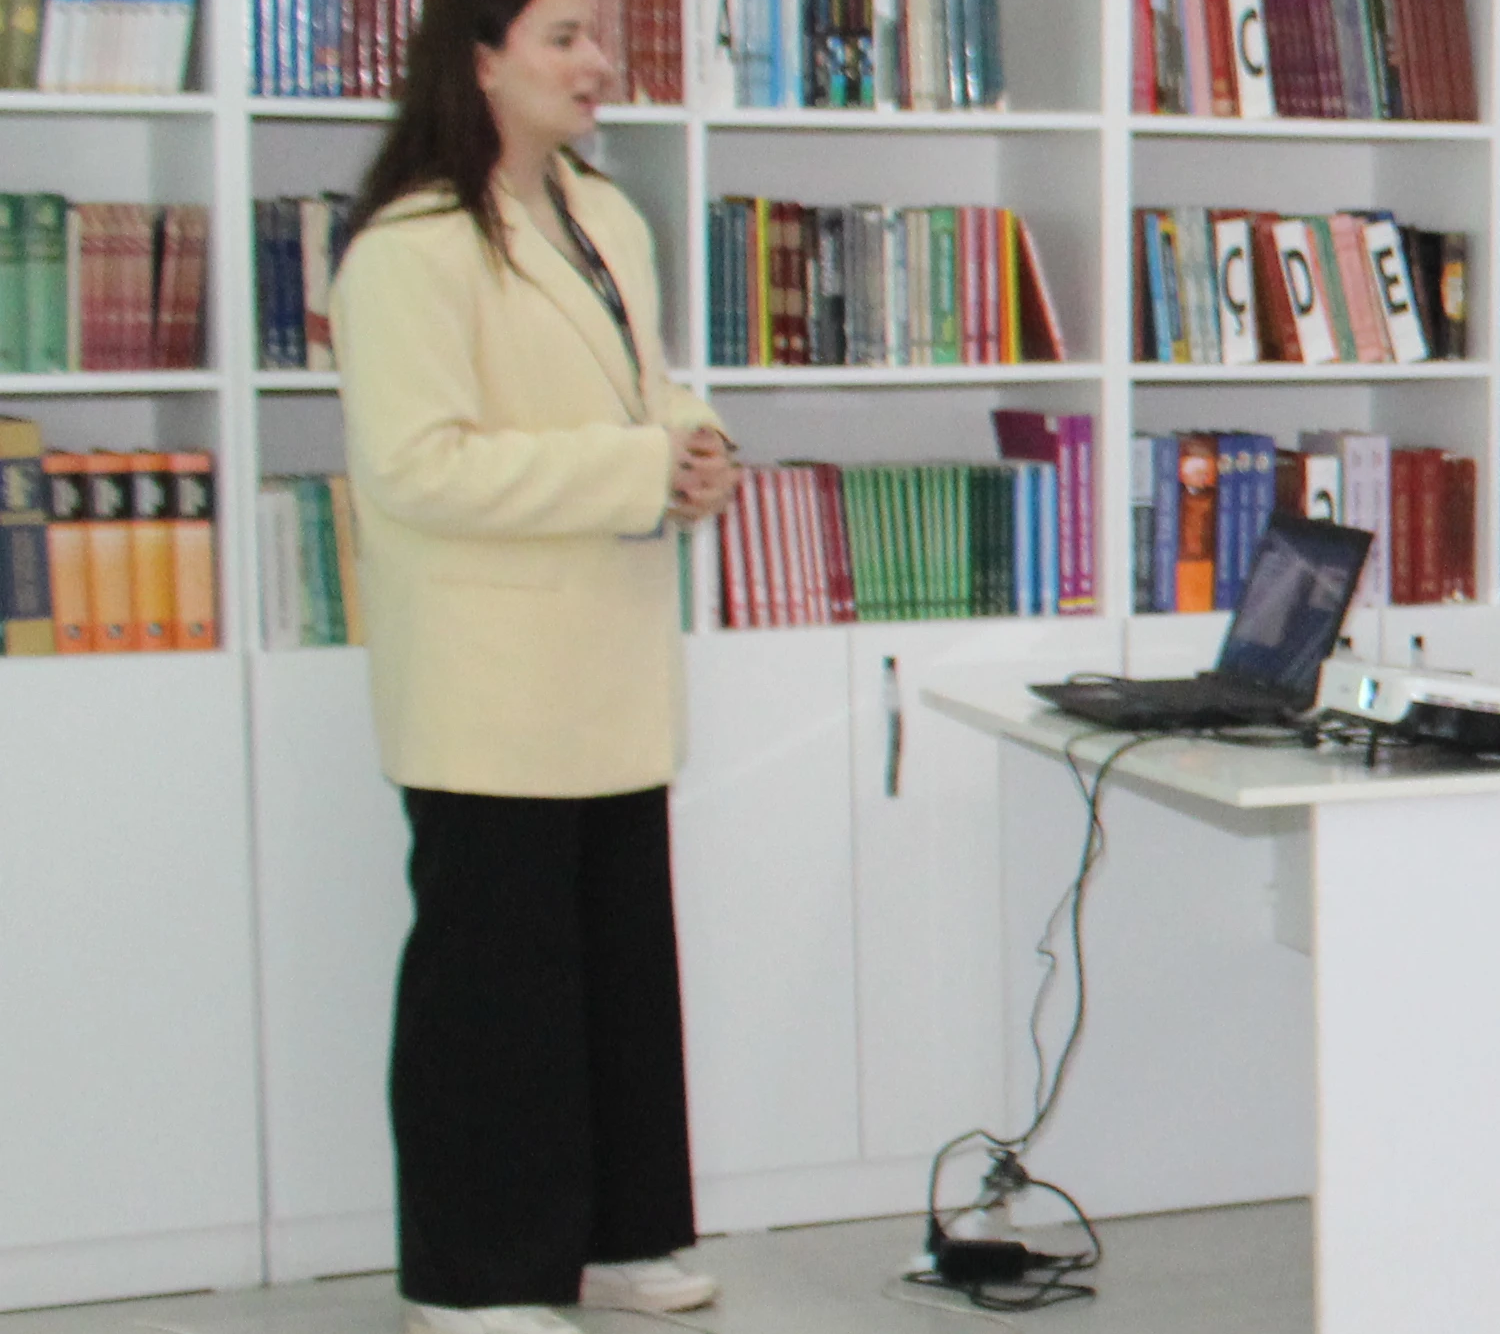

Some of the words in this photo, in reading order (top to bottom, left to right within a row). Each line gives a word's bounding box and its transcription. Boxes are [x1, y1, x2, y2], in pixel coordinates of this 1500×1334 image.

[1238, 7, 1264, 76] C
[1221, 246, 1246, 336] Ç
[1288, 248, 1314, 317] D
[1375, 248, 1408, 315] E
